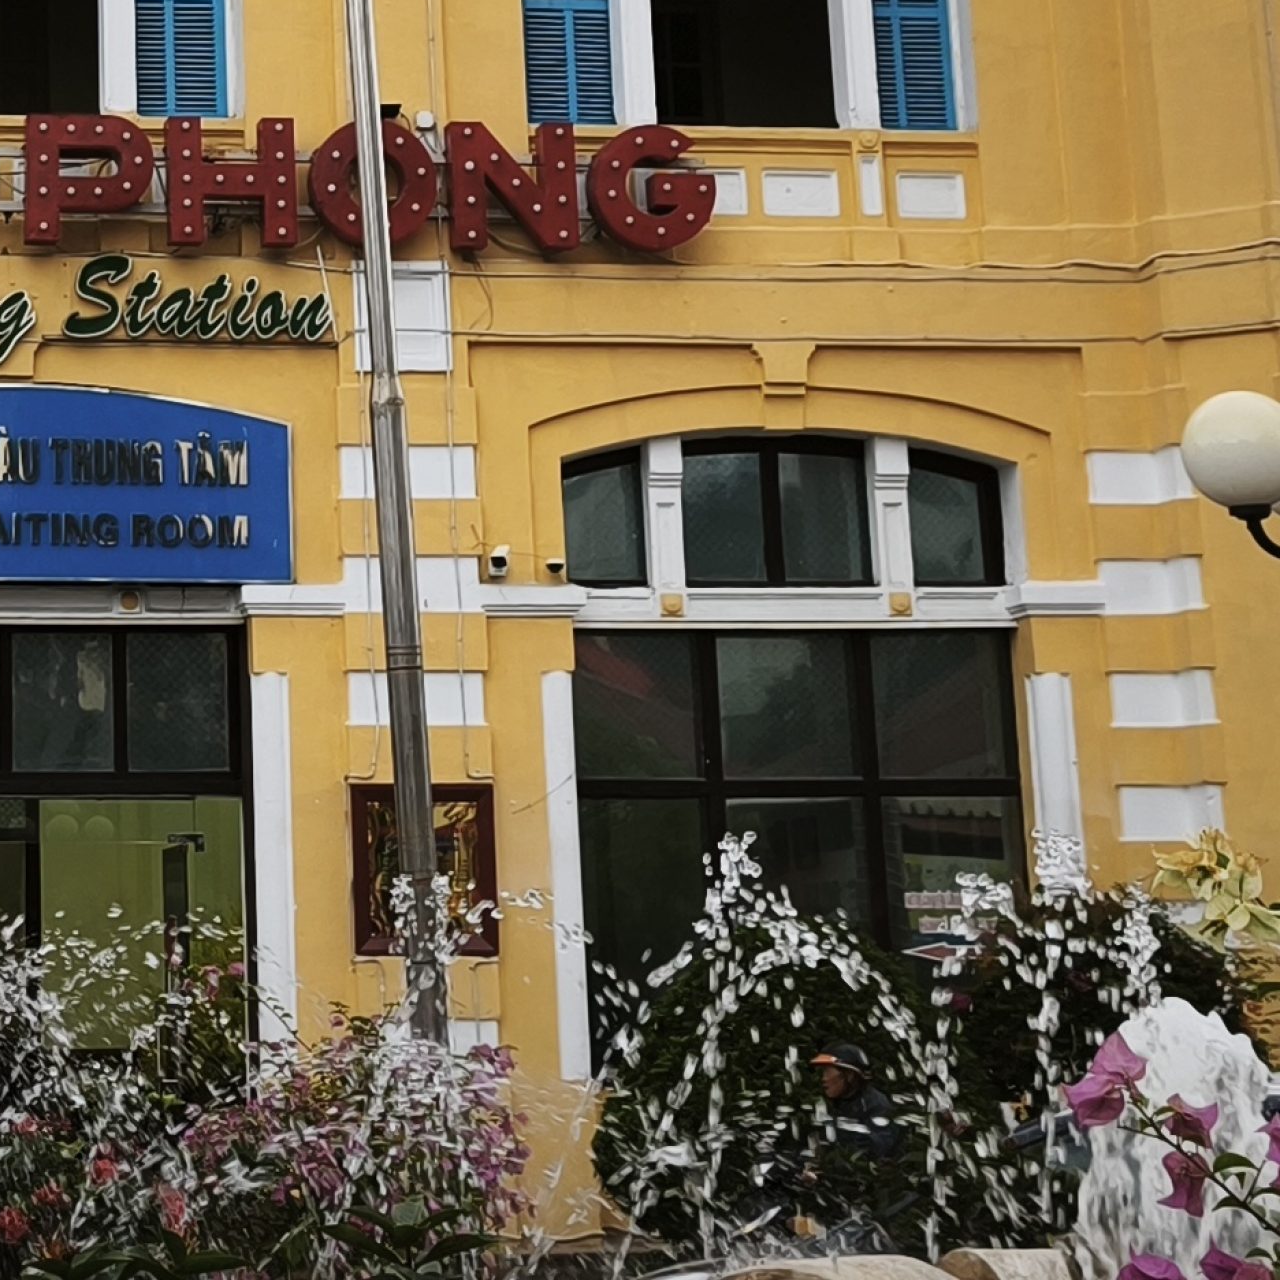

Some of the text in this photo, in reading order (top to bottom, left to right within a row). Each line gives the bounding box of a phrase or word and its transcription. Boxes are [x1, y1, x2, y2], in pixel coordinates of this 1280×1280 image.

[24, 114, 718, 254] PHONG
[63, 253, 335, 342] Station
[130, 514, 249, 548] ROOM
